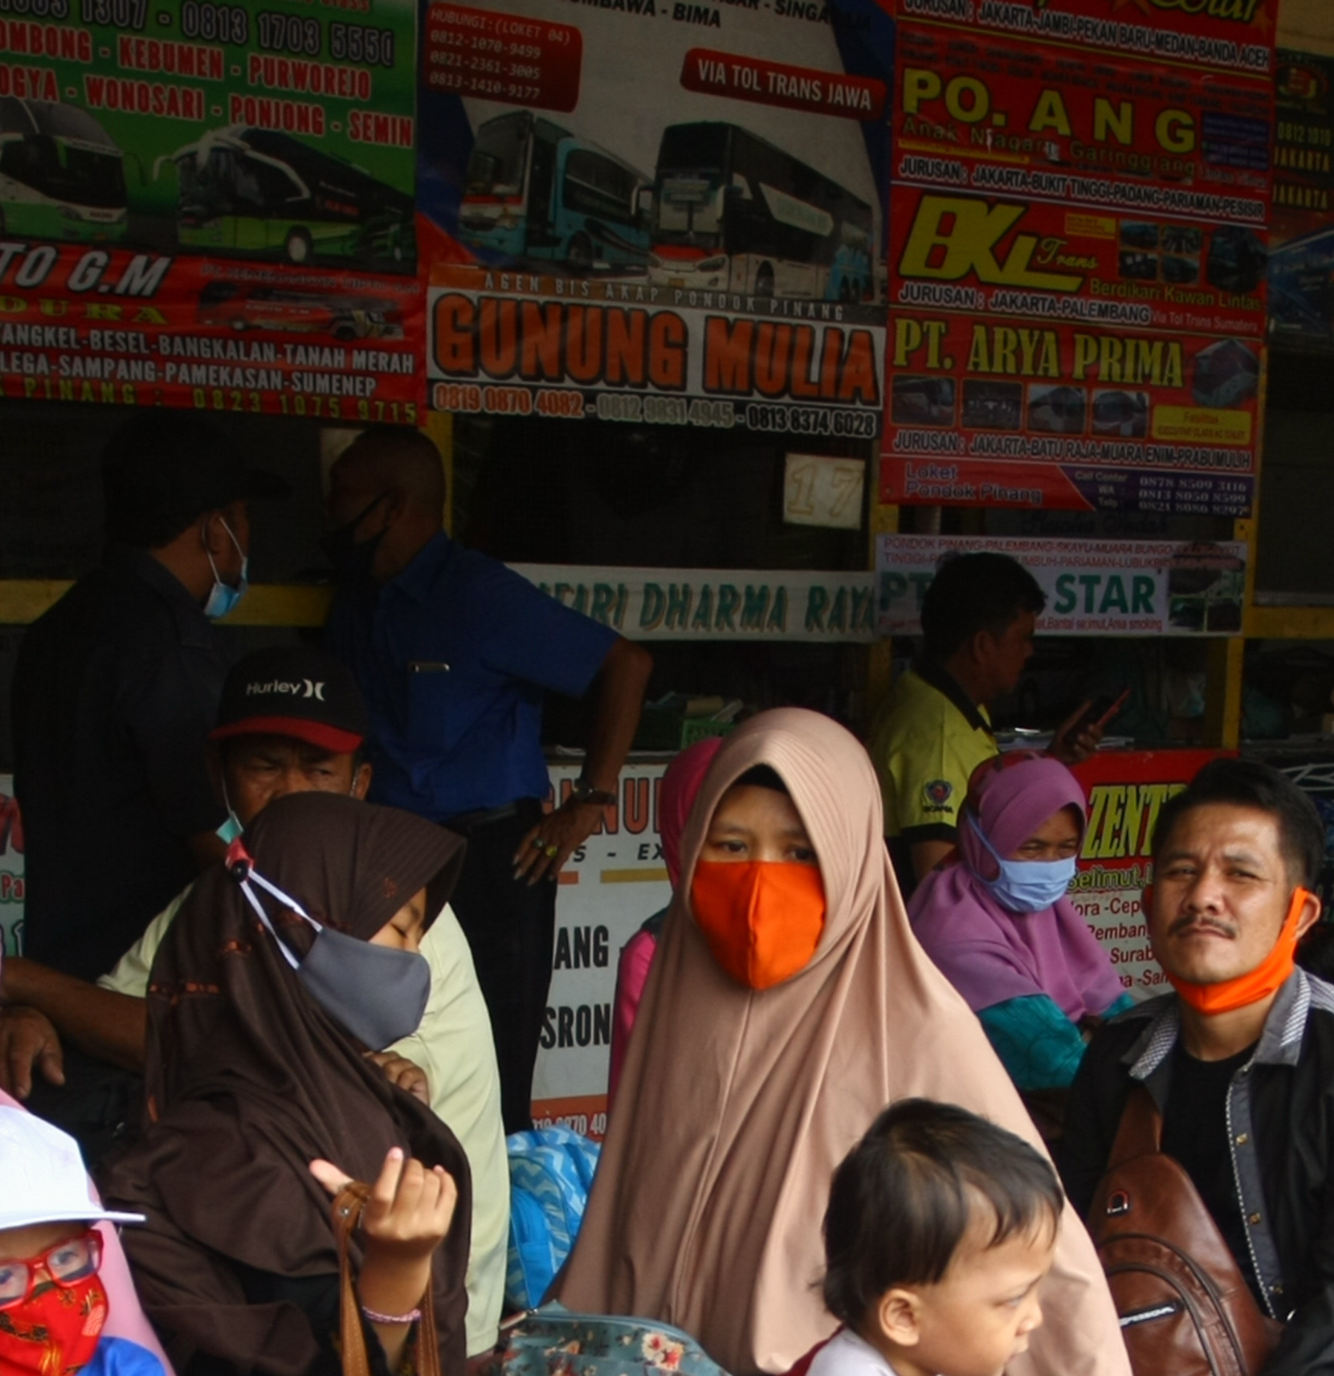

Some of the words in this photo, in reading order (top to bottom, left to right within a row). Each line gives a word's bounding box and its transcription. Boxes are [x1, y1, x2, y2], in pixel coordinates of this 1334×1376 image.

[182, 3, 247, 44] 0813
[258, 13, 320, 56] 1703
[672, 5, 721, 28] BIMA
[117, 35, 224, 81] KEBUMEN
[247, 53, 371, 101] PURWOREJO
[697, 58, 727, 84] VIA
[732, 65, 761, 91] TOL
[768, 72, 822, 101] TRANS
[827, 83, 872, 111] JAWA
[84, 75, 204, 121] WONOSARI
[228, 94, 325, 135] PONJONG
[347, 112, 413, 148] SEMIN
[903, 67, 1007, 127] PO.
[903, 119, 958, 142] Anak
[900, 156, 962, 180] JURUSAN
[972, 165, 1067, 193] JAKARTA-BUKIT
[1273, 146, 1331, 173] JAKARTA
[1272, 184, 1328, 211] JAKARTA
[69, 249, 171, 298] G.M
[1090, 278, 1160, 300] Berdikari
[1164, 286, 1214, 306] Kawan
[1219, 291, 1261, 310] Lintas
[484, 273, 540, 293] AGEN
[555, 279, 590, 297] BIS
[605, 283, 658, 303] AKAP
[674, 290, 754, 312] PONDOK
[770, 300, 844, 322] PINANG
[900, 284, 974, 307] JURUSAN
[990, 292, 1151, 323] JAKARTA-PALEMBANG
[352, 345, 414, 374] MERAH
[434, 294, 688, 391] GUNUNG
[704, 316, 880, 404] MULIA
[893, 318, 953, 370] PT.
[967, 324, 1060, 378] ARYA
[1073, 334, 1184, 388] PRIMA
[24, 379, 137, 405] PINANG
[193, 387, 263, 411] 0823
[278, 393, 341, 418] 1075
[359, 400, 419, 423] 9715
[435, 384, 480, 409] 0819
[485, 386, 529, 412] 0870
[535, 390, 583, 415] 4082
[747, 405, 786, 432] 0813
[791, 408, 829, 434] 8374
[833, 411, 874, 437] 6028
[894, 433, 958, 453] JURUSAN
[970, 437, 1063, 459] JAKARTA-BATU
[1066, 442, 1143, 464] RAJA-MUARA
[787, 462, 864, 516] 17
[905, 464, 957, 481] Loket
[905, 481, 974, 499] Pondok
[980, 484, 1043, 504] Pinang
[885, 537, 936, 550] PONDOK
[639, 582, 788, 632] DHARMA
[1054, 573, 1155, 614] STAR
[245, 678, 301, 698] Hurley
